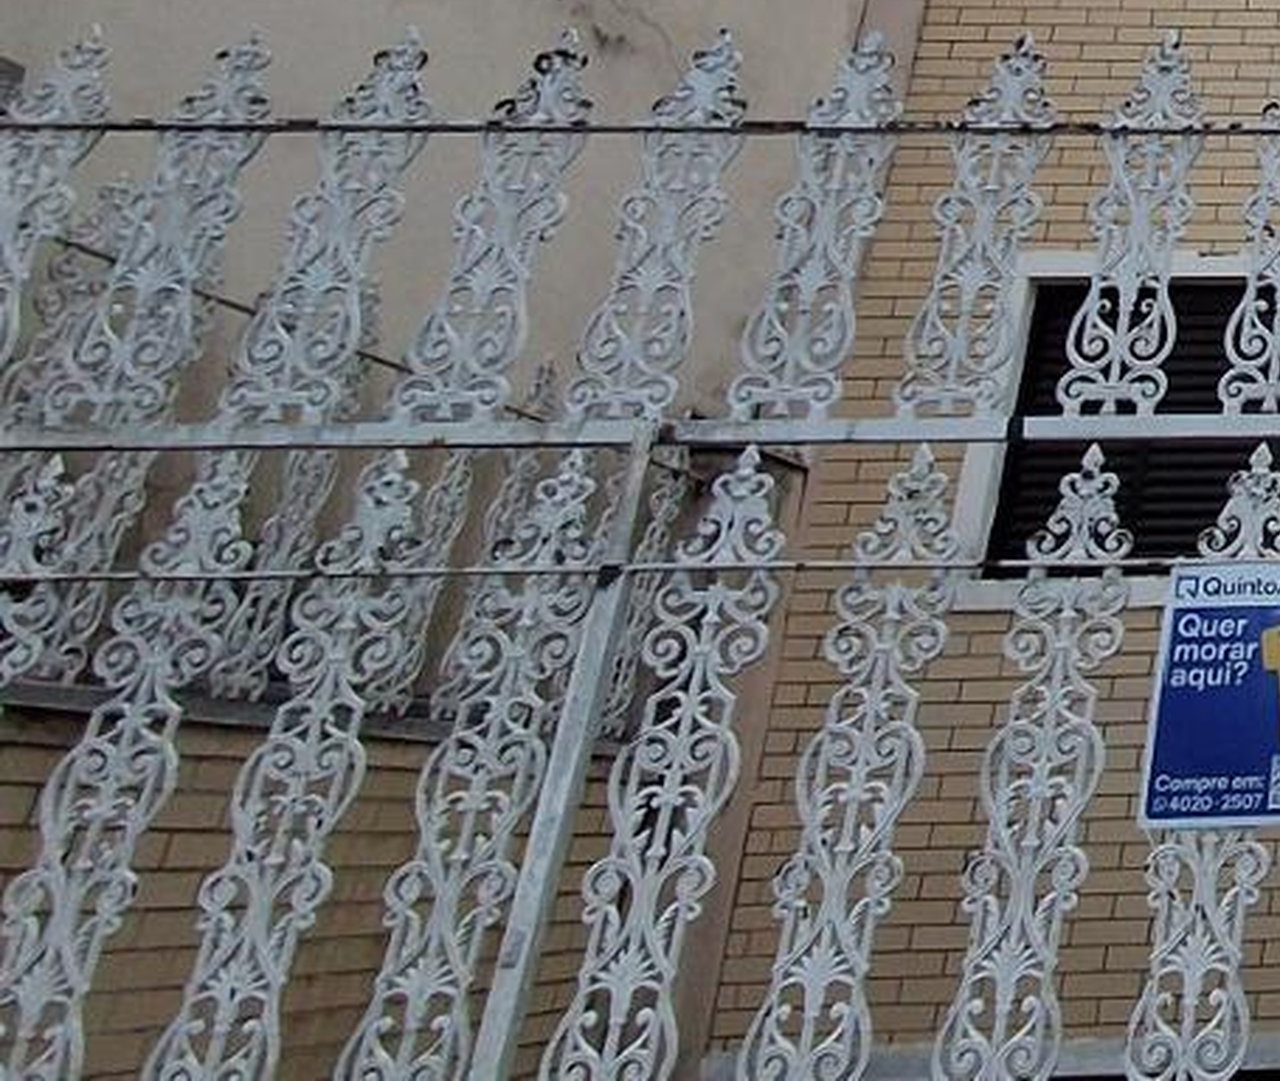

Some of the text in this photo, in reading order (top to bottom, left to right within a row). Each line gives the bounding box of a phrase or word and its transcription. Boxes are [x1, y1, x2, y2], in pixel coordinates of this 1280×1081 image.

[1177, 613, 1248, 638] Quer
[1173, 641, 1259, 662] morar
[1170, 661, 1249, 691] aqui?
[1155, 774, 1229, 794] Compre
